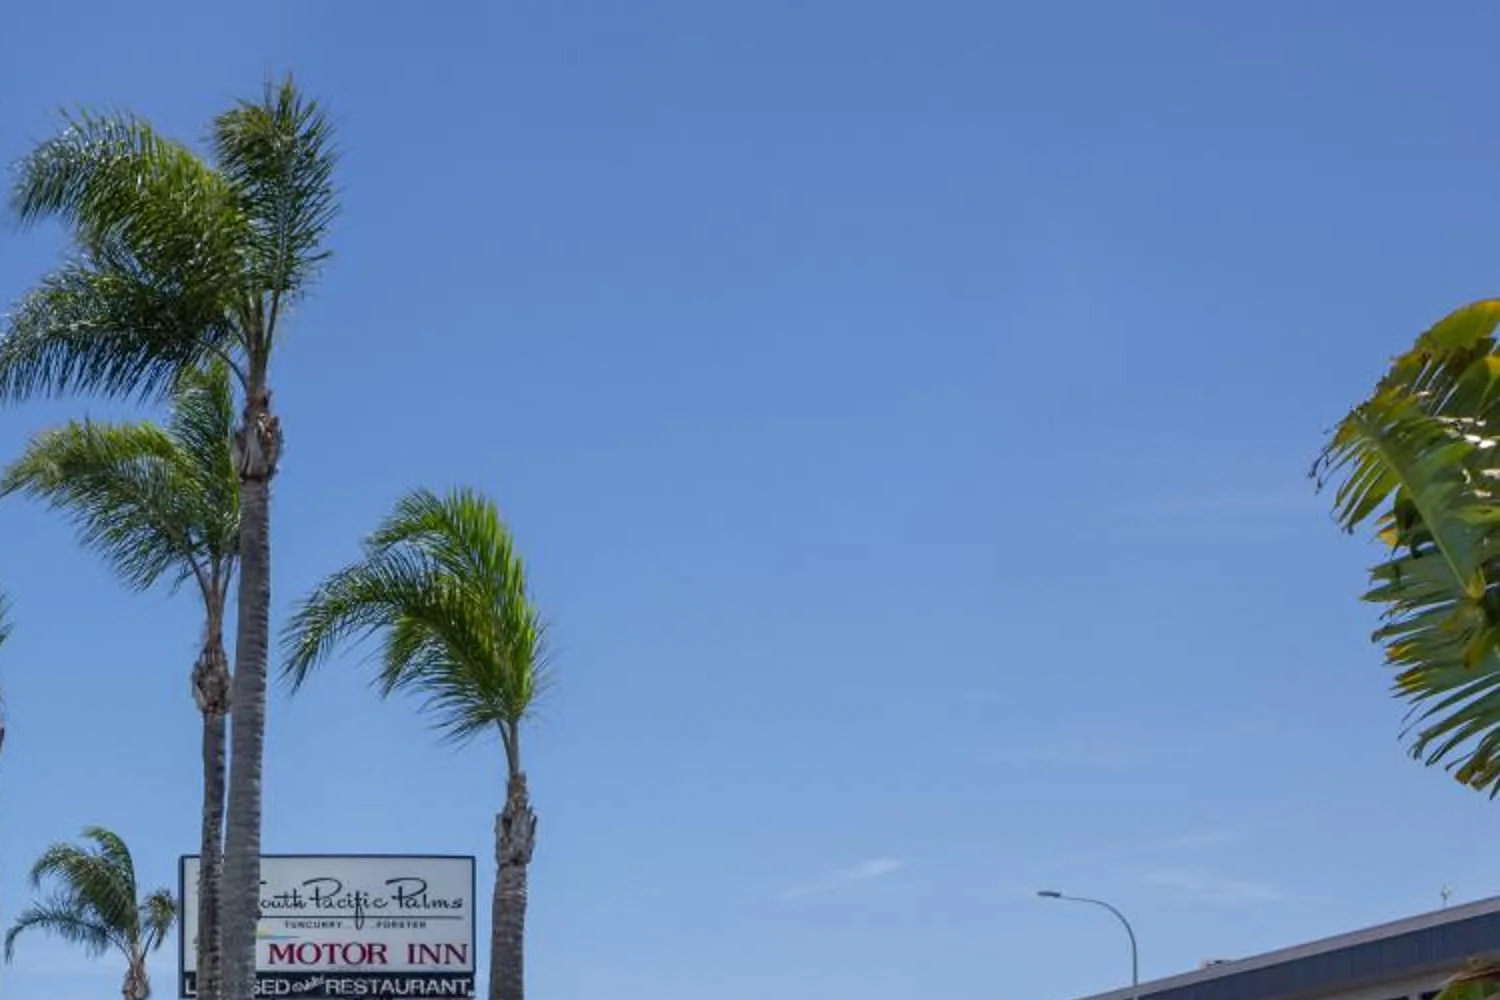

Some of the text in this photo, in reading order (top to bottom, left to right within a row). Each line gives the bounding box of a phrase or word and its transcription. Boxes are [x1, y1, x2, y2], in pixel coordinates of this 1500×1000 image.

[258, 877, 464, 930] outh Pacific Palms
[284, 920, 427, 929] TUNCURRY FORSTER
[267, 943, 469, 965] MOTOR INN
[185, 978, 290, 996] LSED
[325, 978, 470, 996] RESTAURANT
